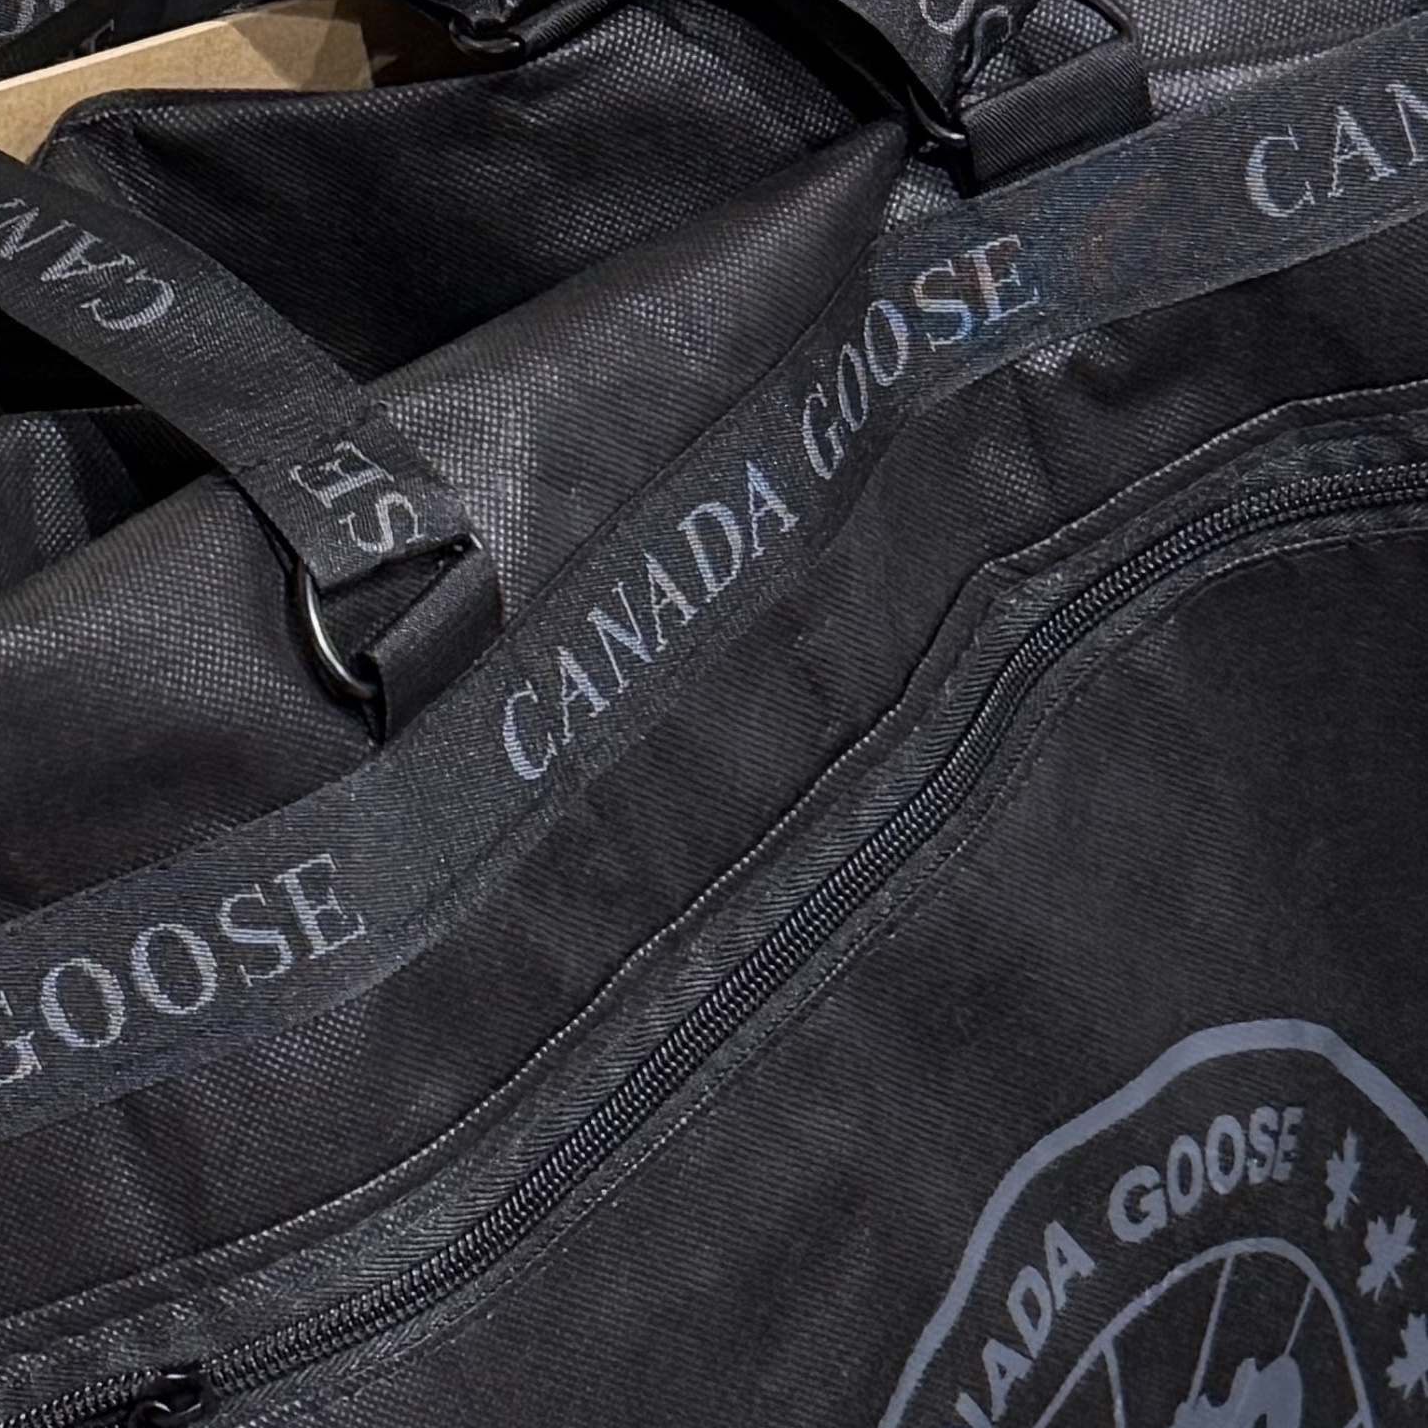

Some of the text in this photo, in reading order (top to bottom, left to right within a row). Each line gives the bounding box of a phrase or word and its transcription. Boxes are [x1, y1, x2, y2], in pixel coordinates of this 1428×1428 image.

[501, 233, 1041, 781] CANADA GOOSE
[1107, 1105, 1305, 1245] GOOSE
